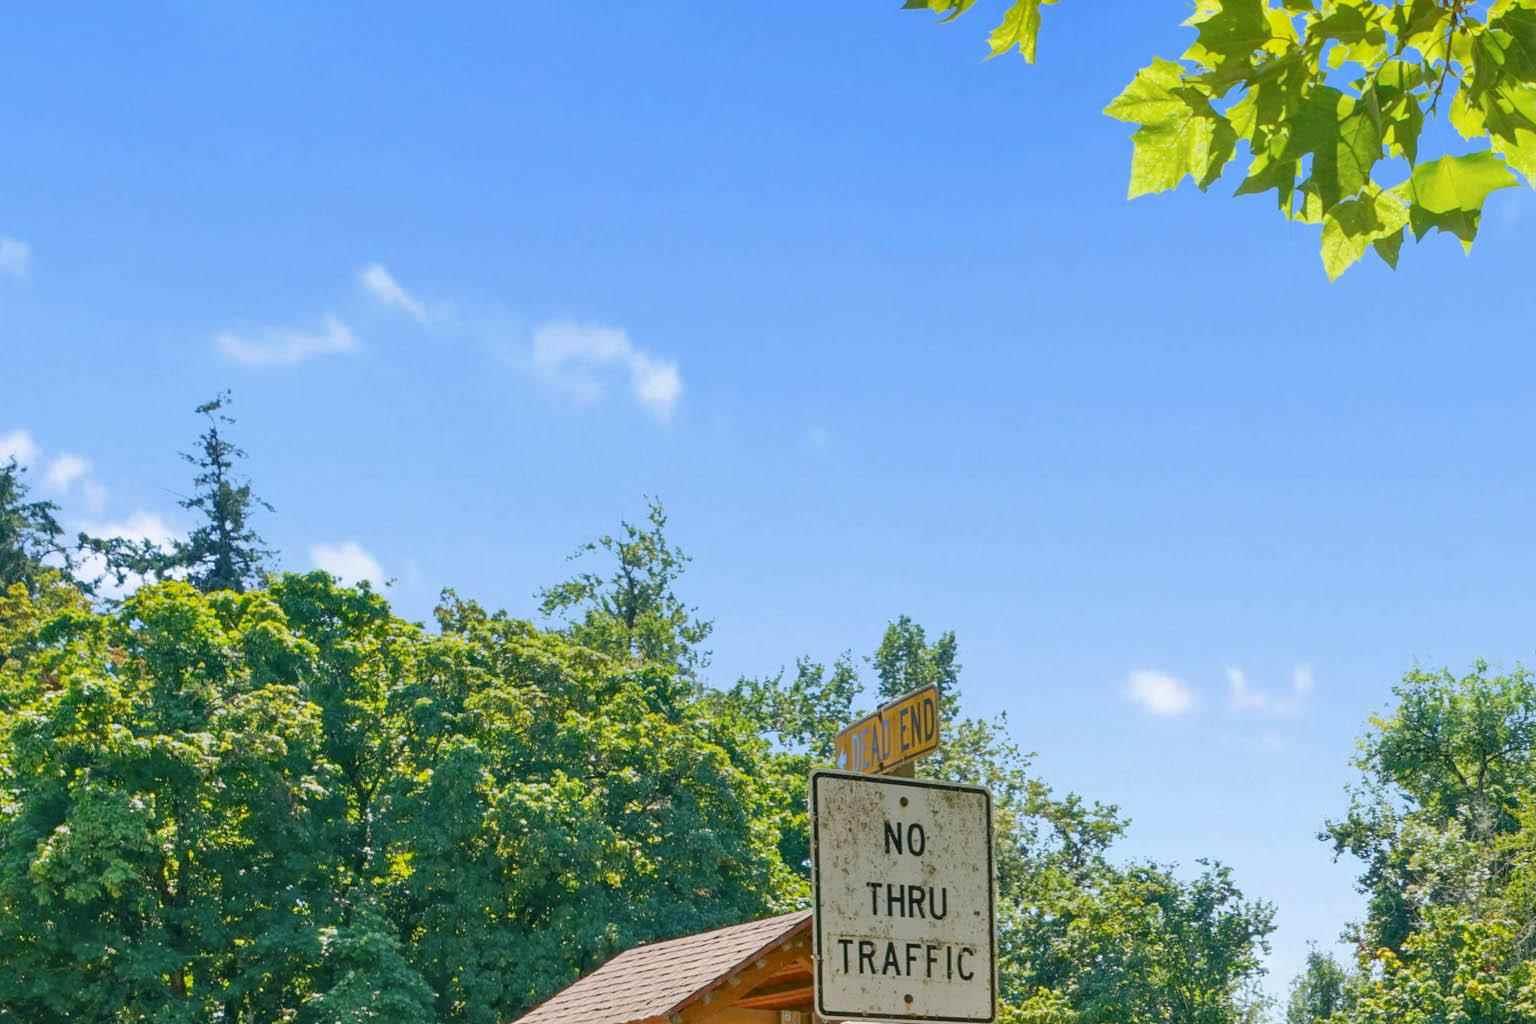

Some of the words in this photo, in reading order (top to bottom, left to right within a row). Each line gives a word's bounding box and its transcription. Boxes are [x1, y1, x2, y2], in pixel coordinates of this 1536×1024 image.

[851, 717, 893, 773] DEAD
[900, 698, 935, 752] END
[884, 822, 926, 857] NO
[866, 882, 949, 921] THRU
[838, 938, 976, 982] TRAFFIC
